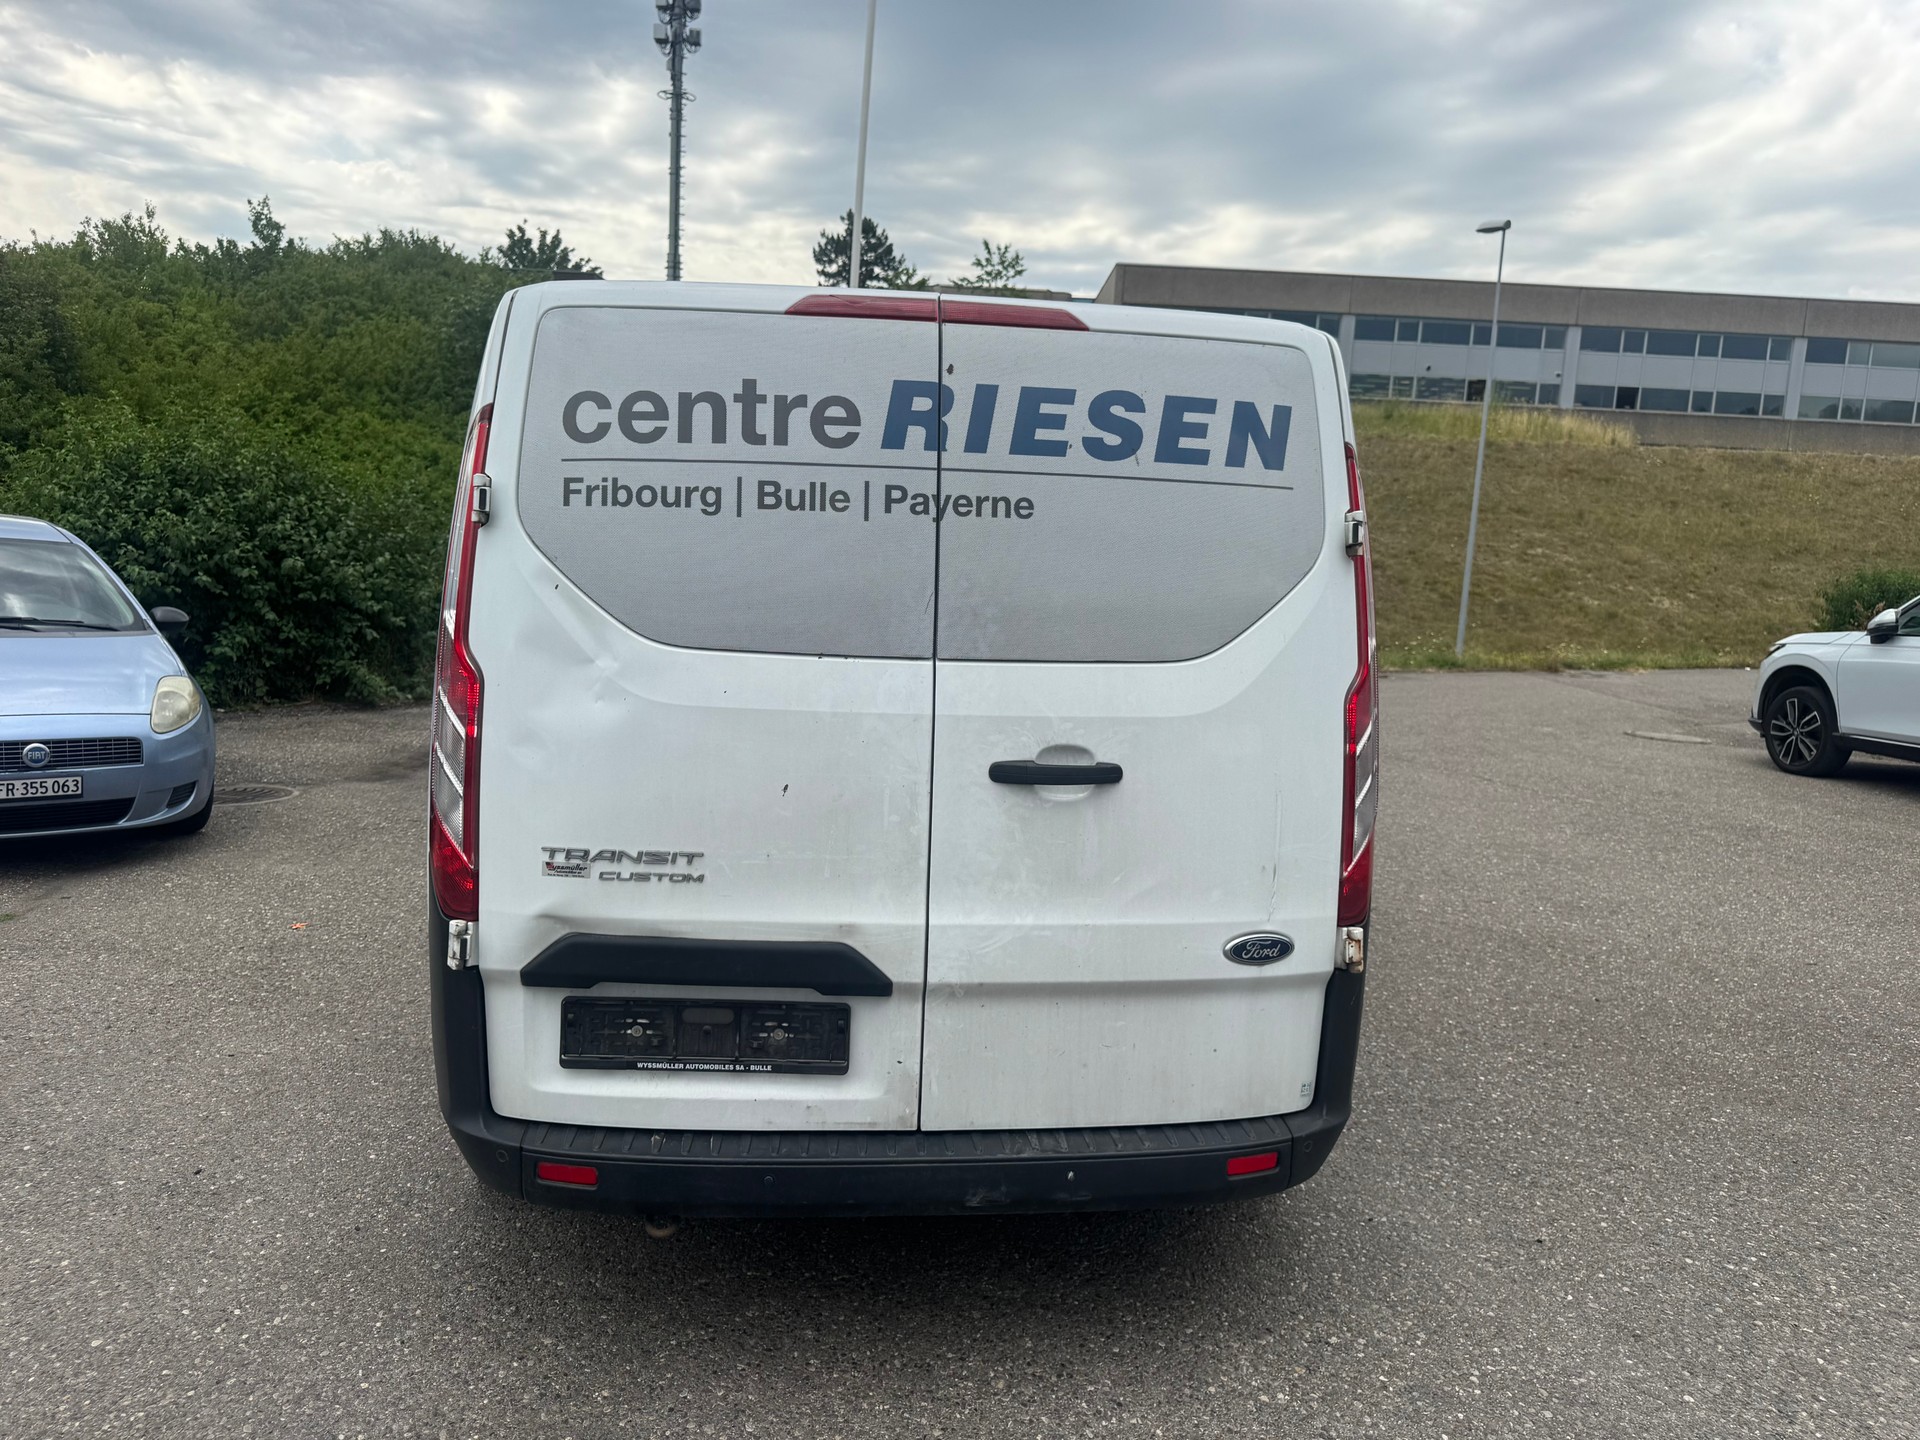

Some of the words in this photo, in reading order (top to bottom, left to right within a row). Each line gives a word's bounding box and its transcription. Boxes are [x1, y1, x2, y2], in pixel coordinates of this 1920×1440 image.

[562, 378, 862, 450] centre
[880, 379, 1293, 472] RIESEN
[562, 477, 723, 517] Fribourg
[757, 480, 851, 513] Bulle
[884, 484, 1036, 523] Payerne
[27, 751, 47, 760] FIAT
[541, 846, 705, 867] TRANSIT
[598, 871, 705, 884] CUSTOM
[1242, 940, 1281, 959] Ford
[685, 1063, 734, 1071] AUTOMOBILES
